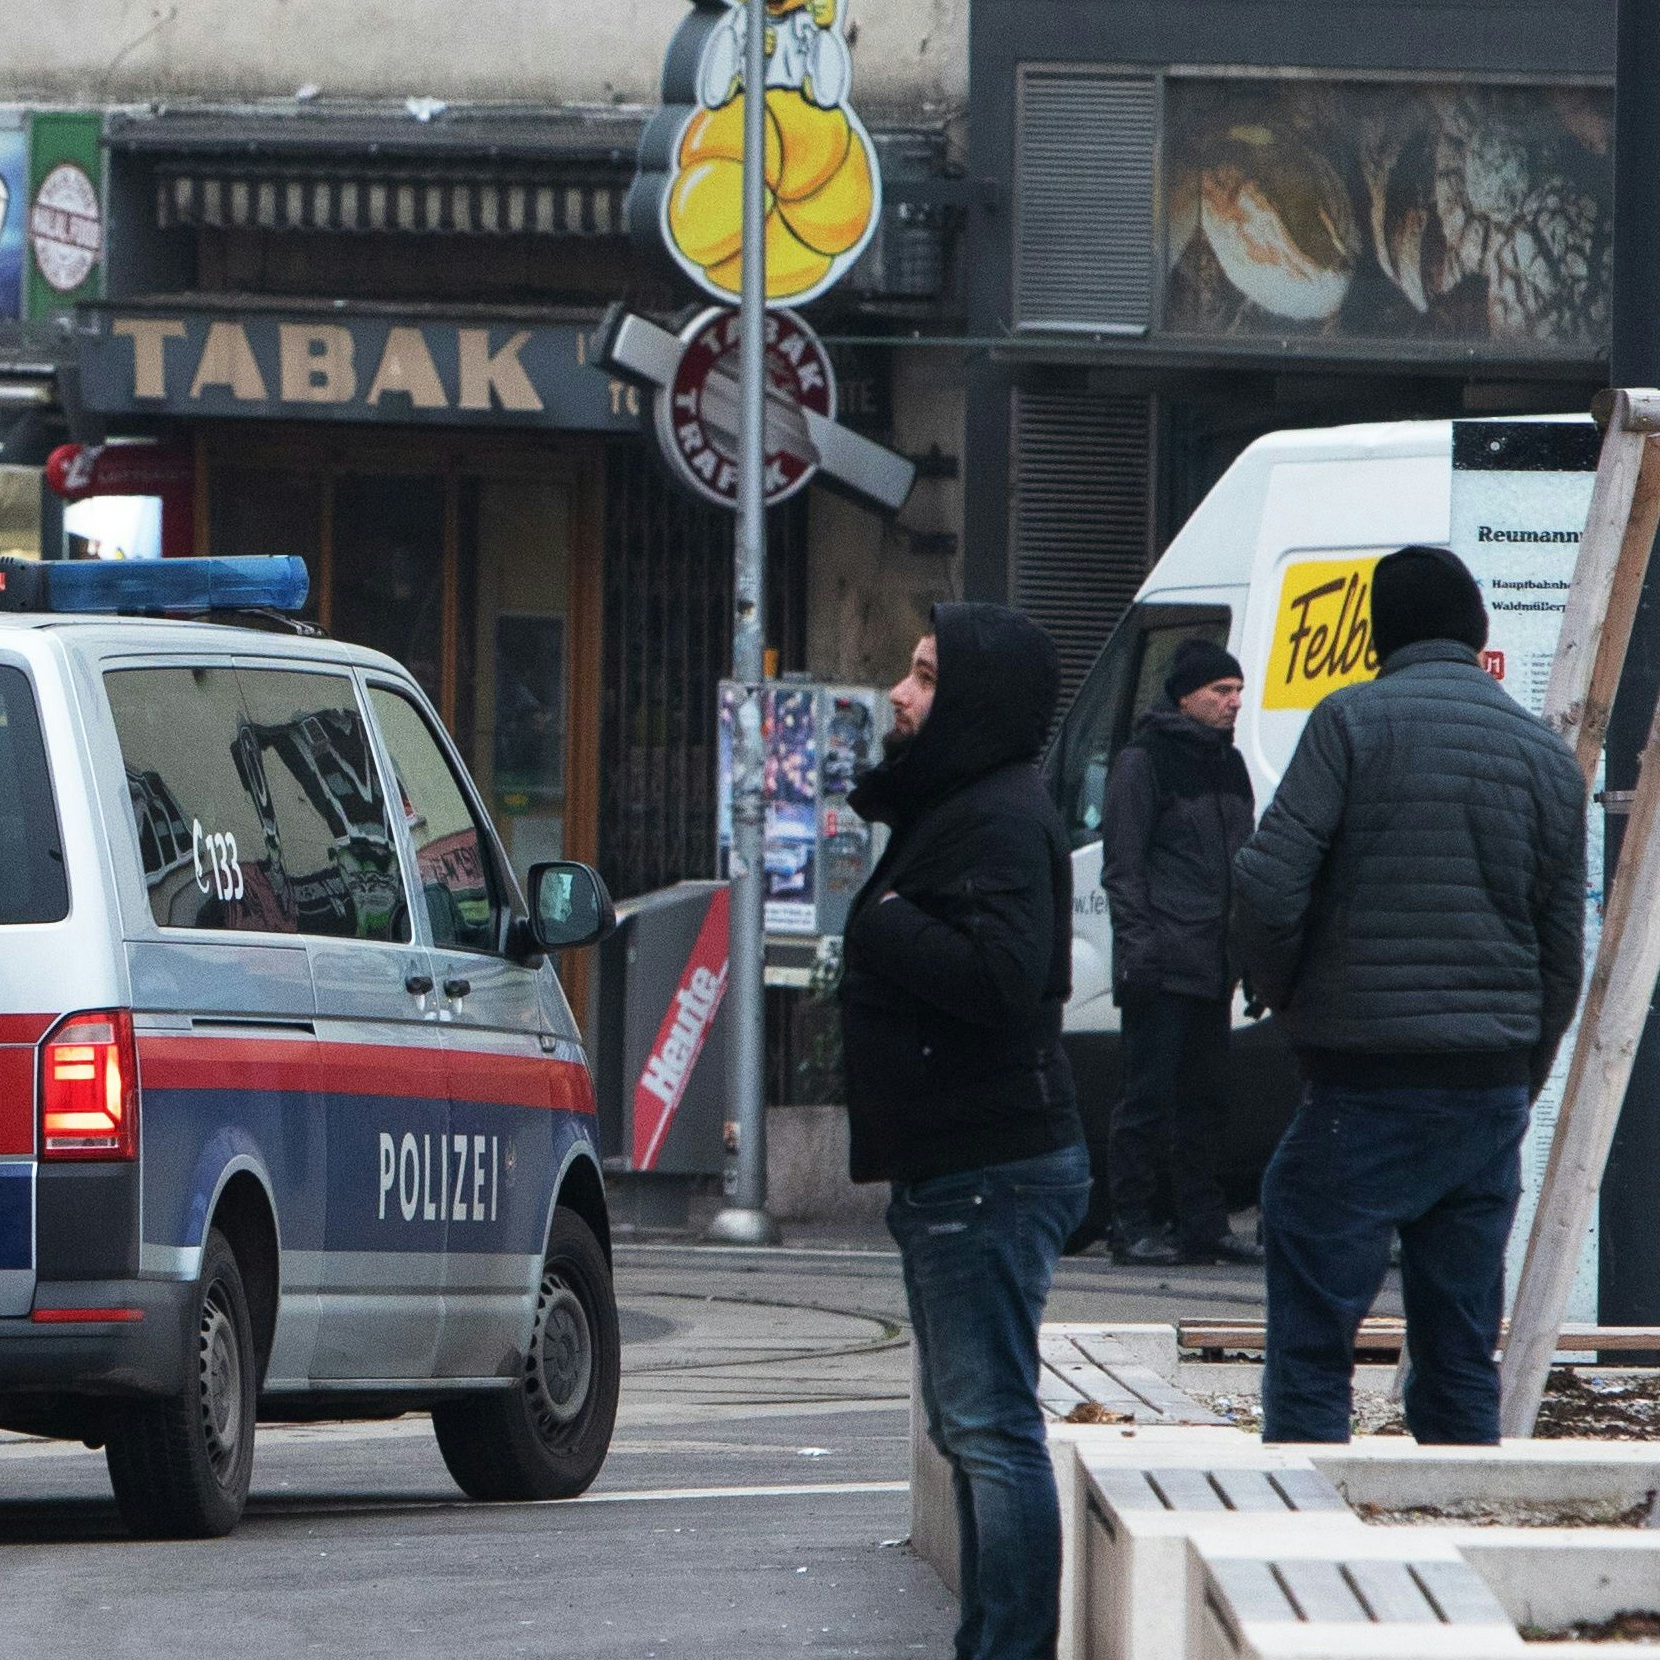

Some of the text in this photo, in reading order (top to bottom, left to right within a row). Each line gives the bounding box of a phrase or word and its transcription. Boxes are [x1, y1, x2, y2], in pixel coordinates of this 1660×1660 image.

[113, 318, 544, 412] TABAK
[676, 388, 789, 492] TRAFK
[205, 832, 244, 900] 133
[641, 966, 720, 1104] Heute
[378, 1131, 498, 1222] POLIZEI
